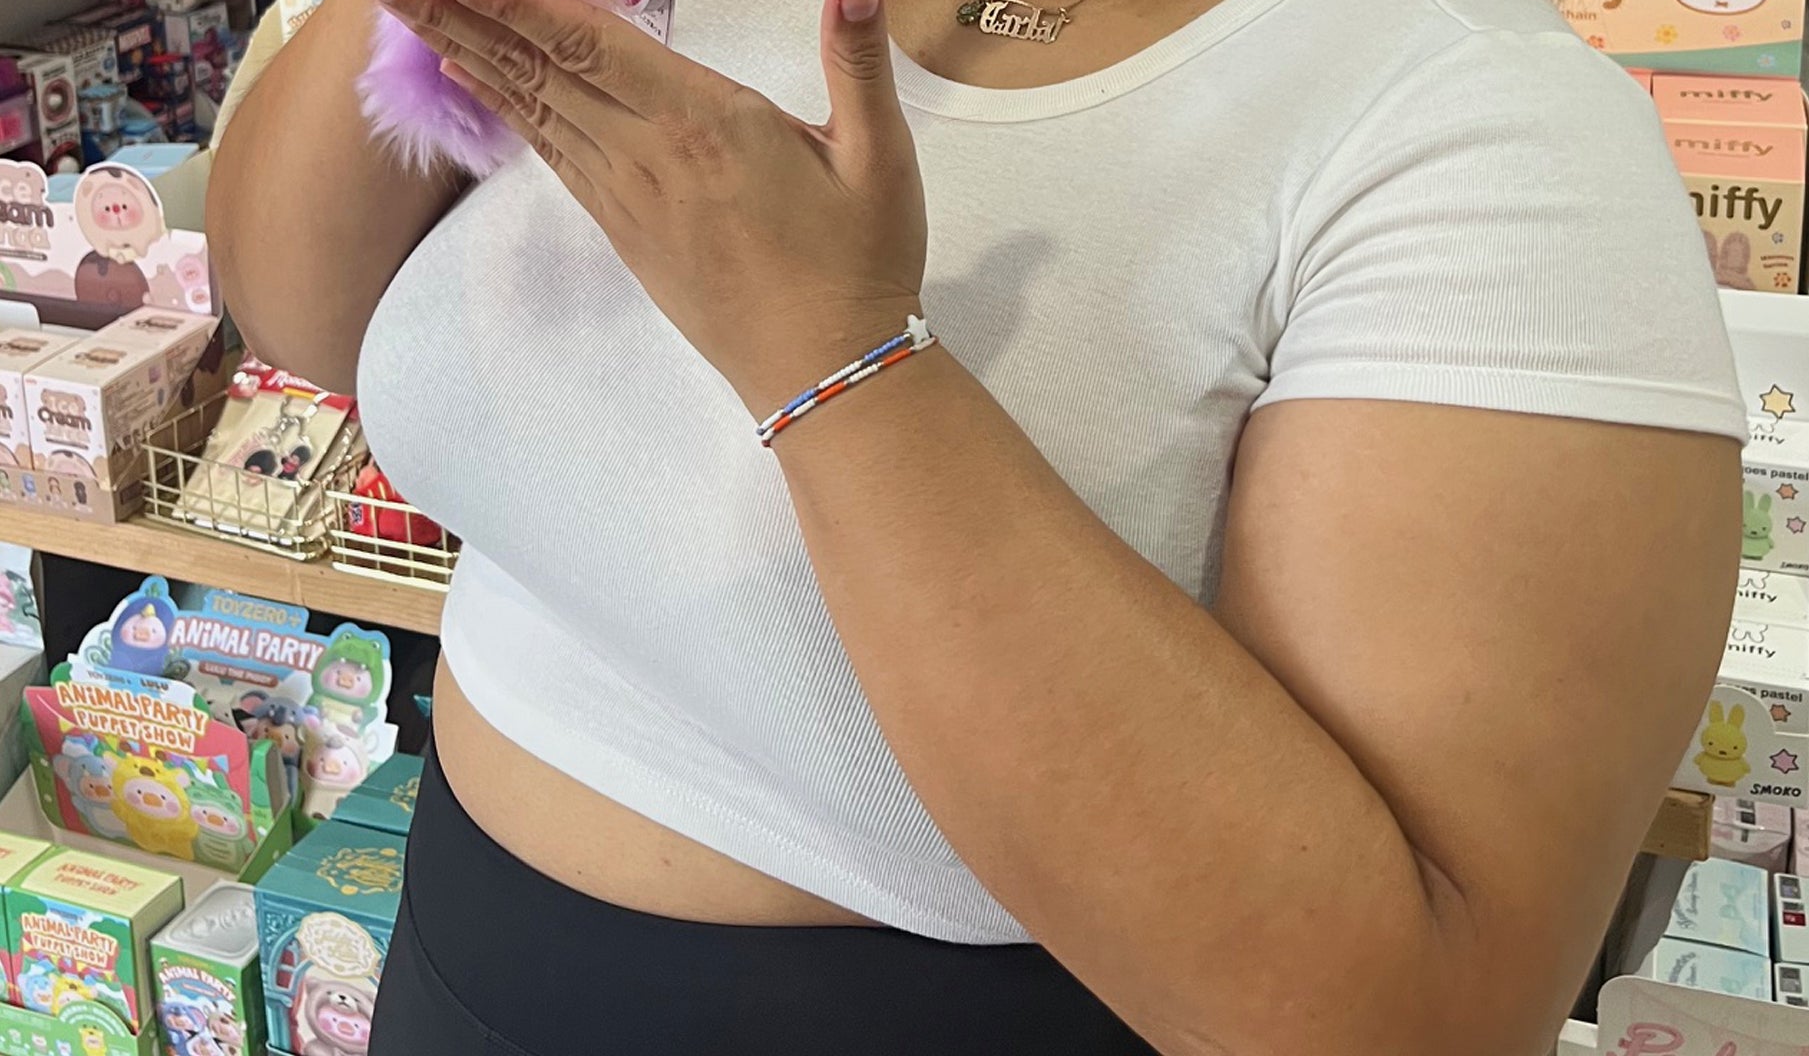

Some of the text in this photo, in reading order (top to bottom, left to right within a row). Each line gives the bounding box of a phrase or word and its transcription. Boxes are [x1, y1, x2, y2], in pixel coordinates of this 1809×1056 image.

[1561, 9, 1597, 21] hain
[1680, 89, 1773, 102] miffy
[1674, 138, 1774, 157] miffy
[1749, 433, 1785, 445] iffy
[1744, 466, 1809, 481] oes pastel
[255, 631, 325, 671] PARTY
[1760, 689, 1803, 703] pastel
[139, 694, 208, 735] PARTY
[75, 709, 196, 752] PUPPET SHOW
[1750, 783, 1802, 797] SMOKO
[72, 926, 118, 956] PARTY
